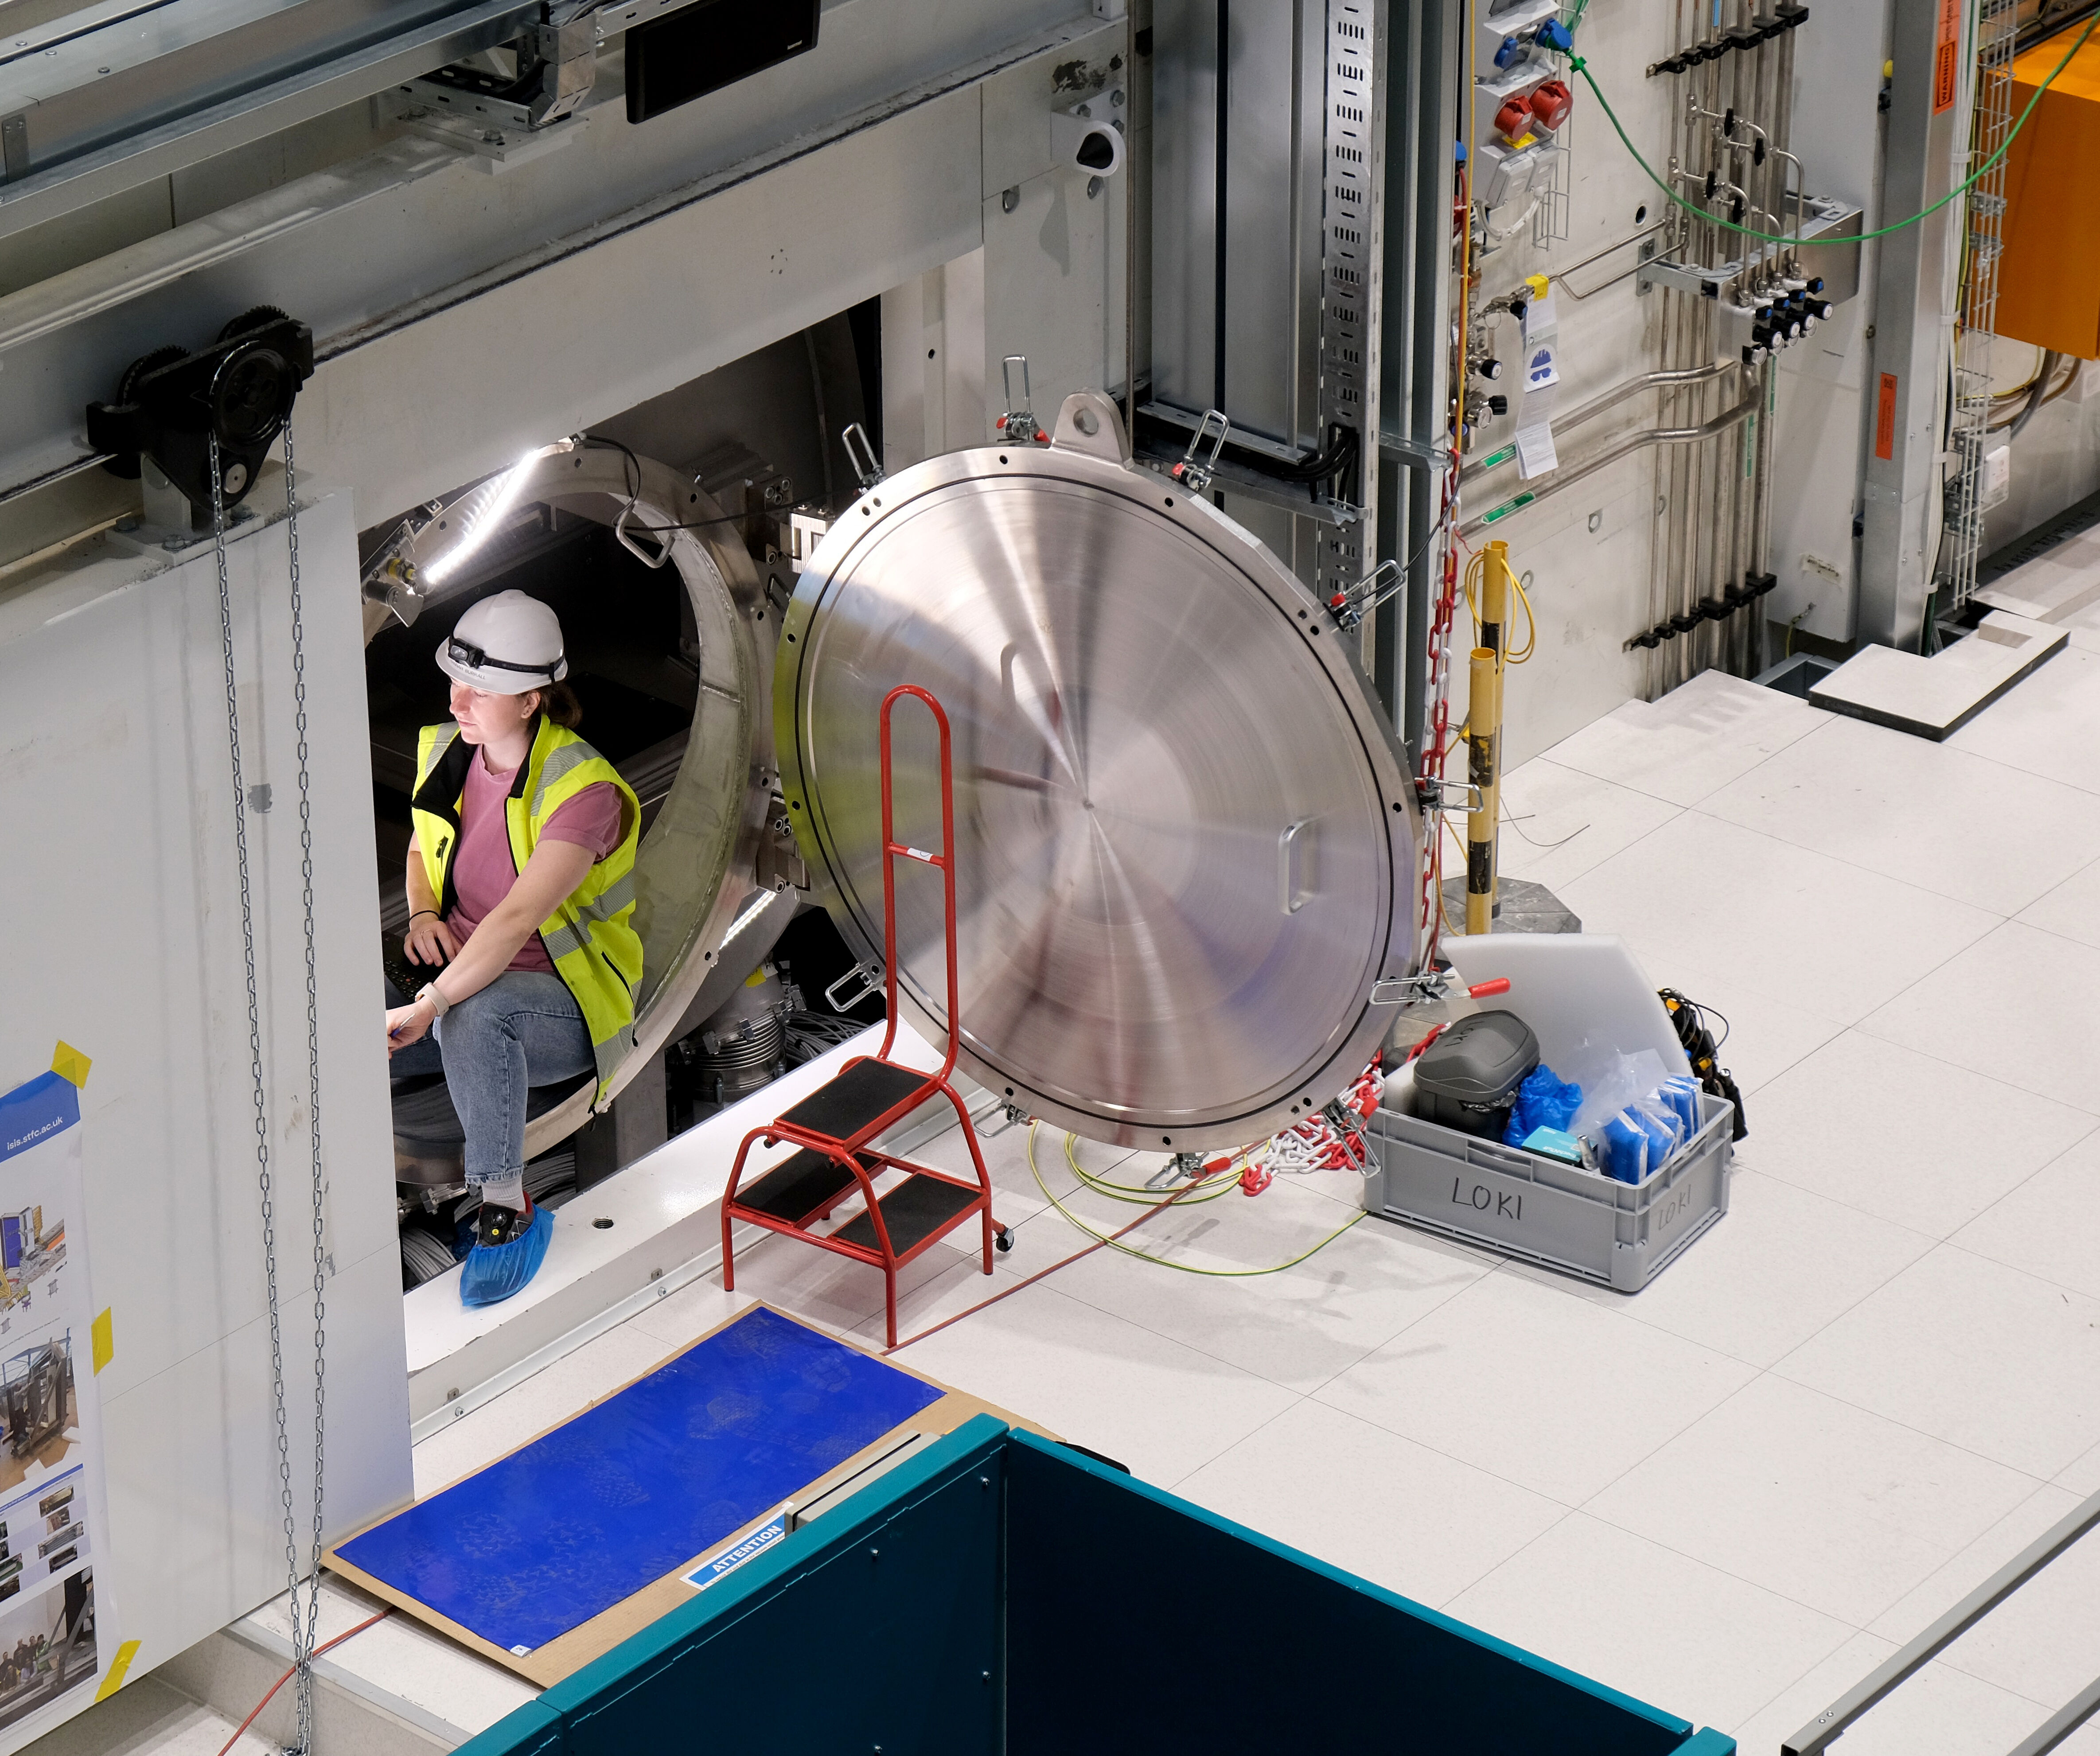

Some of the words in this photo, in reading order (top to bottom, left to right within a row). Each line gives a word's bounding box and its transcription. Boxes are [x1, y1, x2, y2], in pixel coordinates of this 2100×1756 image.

[7, 1116, 63, 1150] isis.stfc.ac.uk
[1452, 1177, 1521, 1220] LOKI
[1659, 1184, 1691, 1230] LOKI
[712, 1525, 783, 1573] ATTENTION
